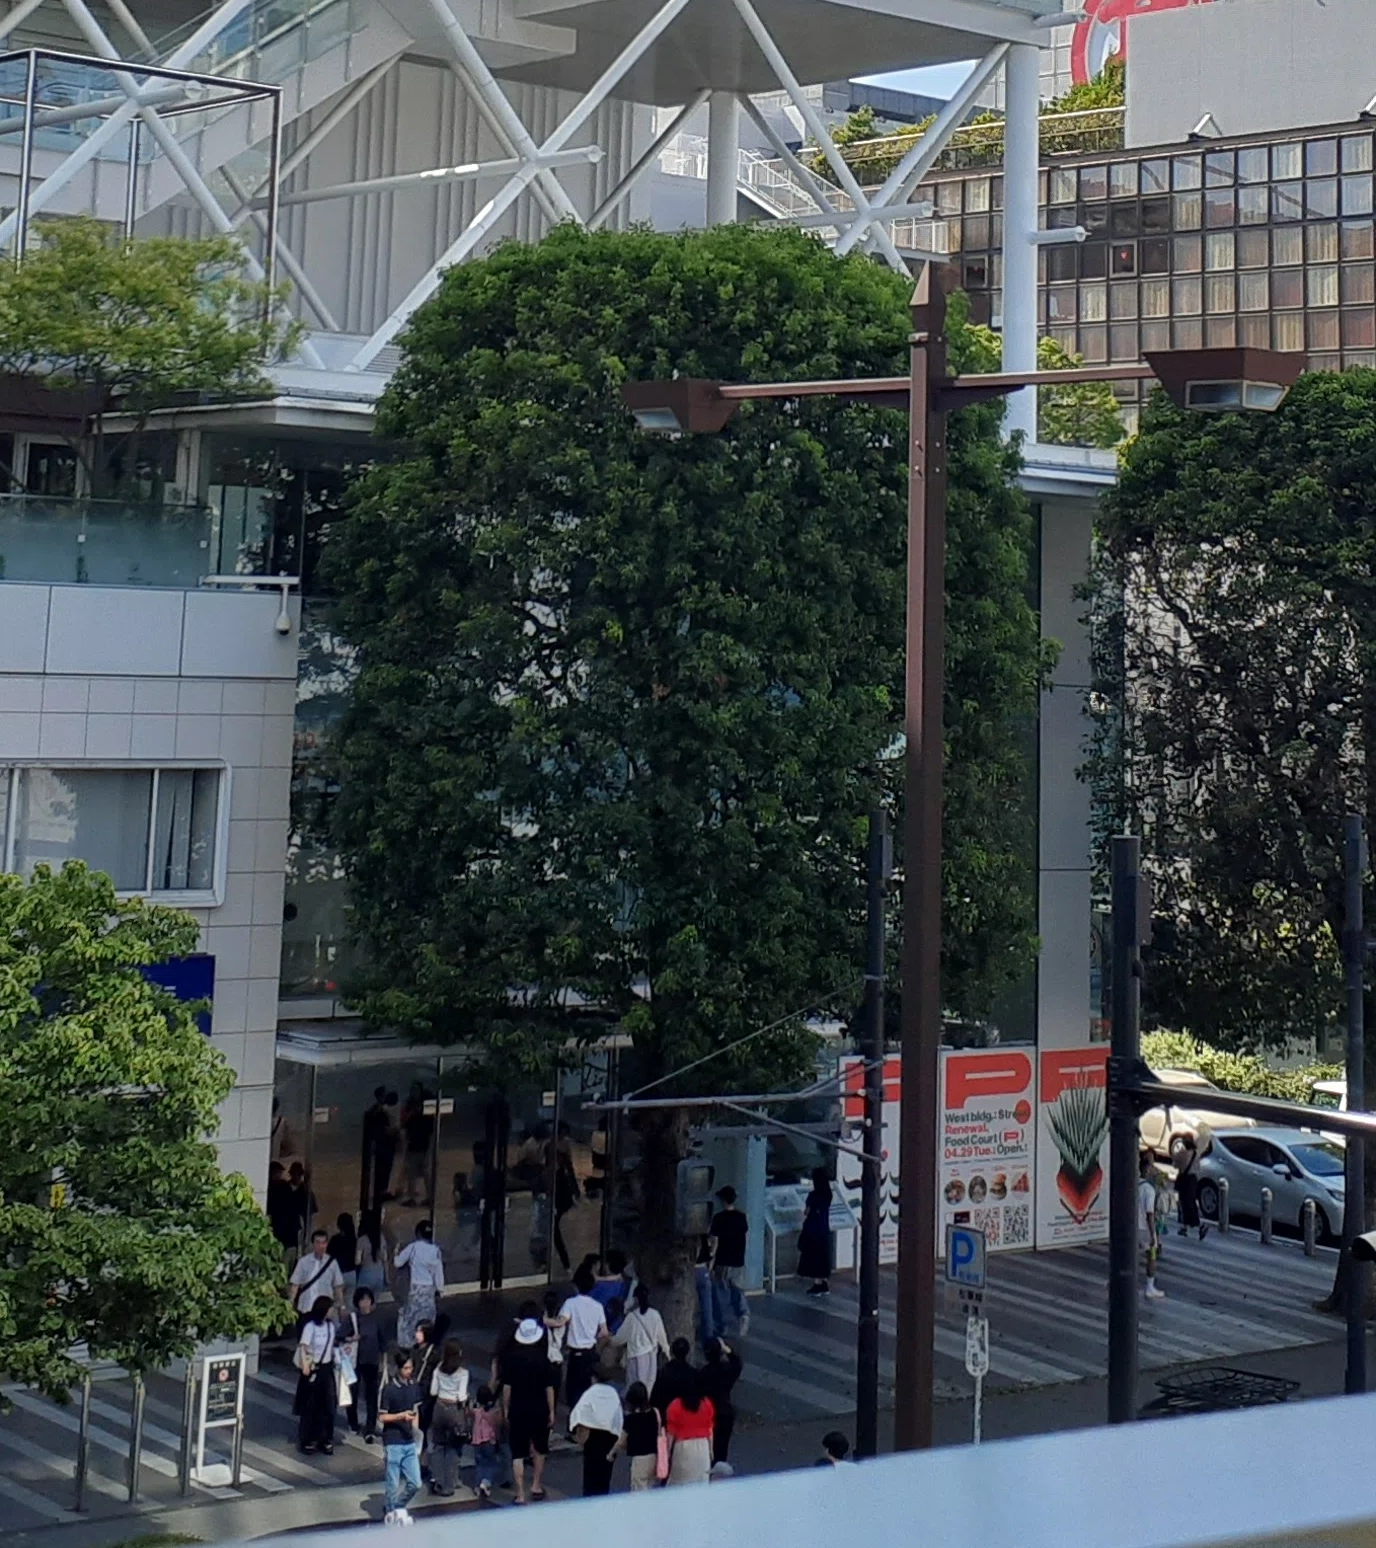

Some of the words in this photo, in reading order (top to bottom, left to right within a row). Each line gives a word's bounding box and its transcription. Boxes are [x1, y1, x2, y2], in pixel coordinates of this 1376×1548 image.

[945, 1113, 970, 1123] West
[945, 1136, 969, 1147] Food
[952, 1231, 974, 1277] P
